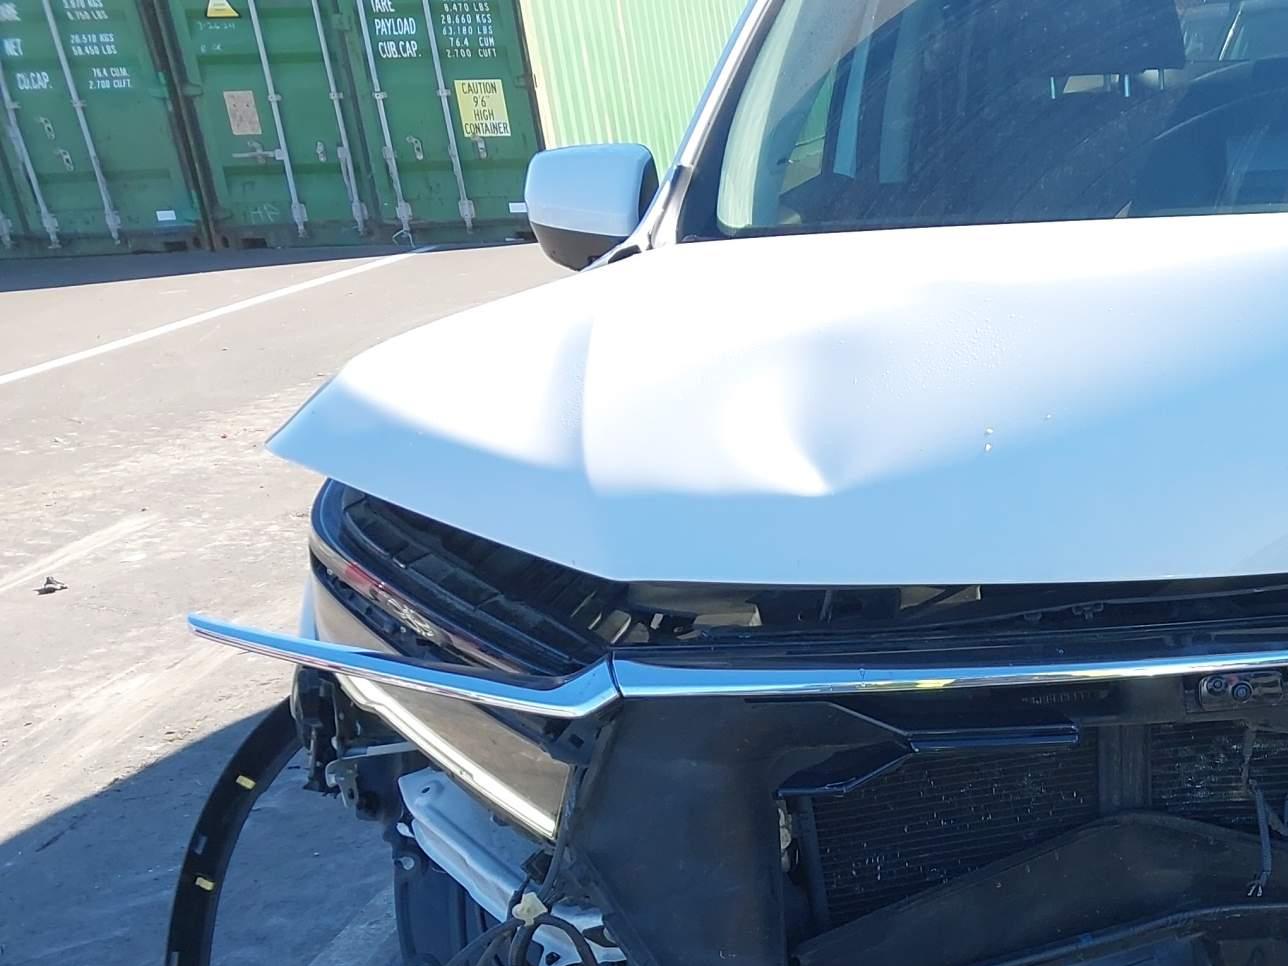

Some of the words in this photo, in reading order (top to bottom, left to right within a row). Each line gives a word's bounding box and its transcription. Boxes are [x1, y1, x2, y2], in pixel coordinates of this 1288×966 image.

[473, 3, 490, 12] LBS
[476, 14, 492, 24] KGS
[374, 17, 417, 35] PAYLOAD
[477, 26, 493, 35] LBS
[3, 38, 24, 56] NET
[449, 37, 469, 47] 76.4
[101, 45, 118, 55] LBS
[378, 41, 422, 58] CUB.CAP.
[461, 82, 497, 95] CAUTION
[473, 109, 495, 121] HIGH
[464, 122, 510, 135] CONTAINER
